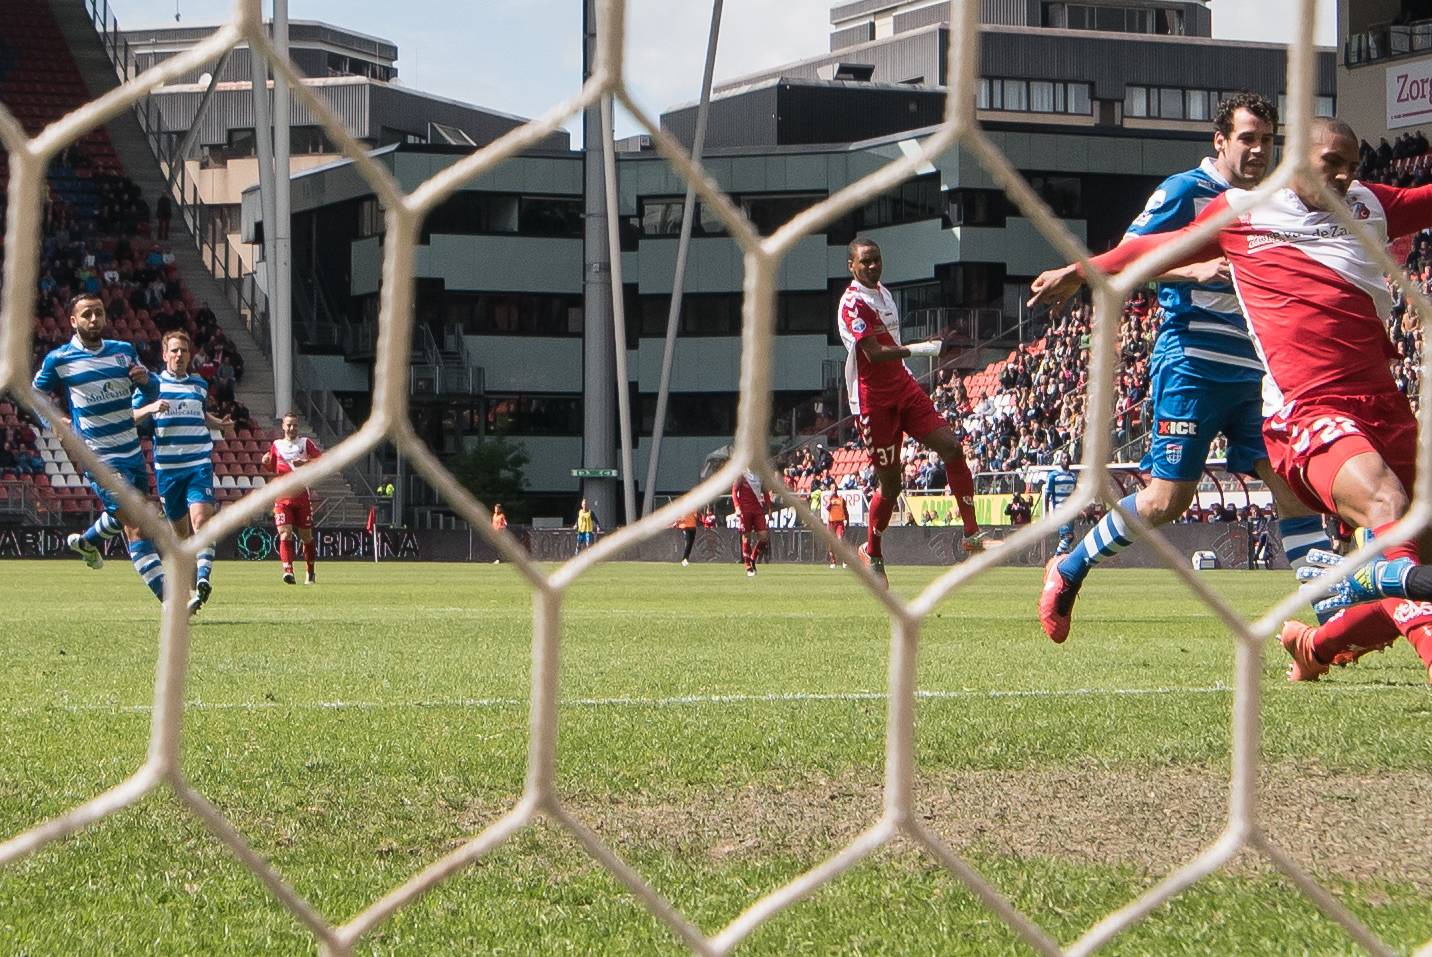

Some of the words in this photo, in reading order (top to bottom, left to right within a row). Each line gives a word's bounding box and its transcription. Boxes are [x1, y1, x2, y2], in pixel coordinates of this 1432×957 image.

[876, 444, 896, 467] 37
[822, 493, 860, 507] SRP
[273, 531, 420, 558] GRDENA
